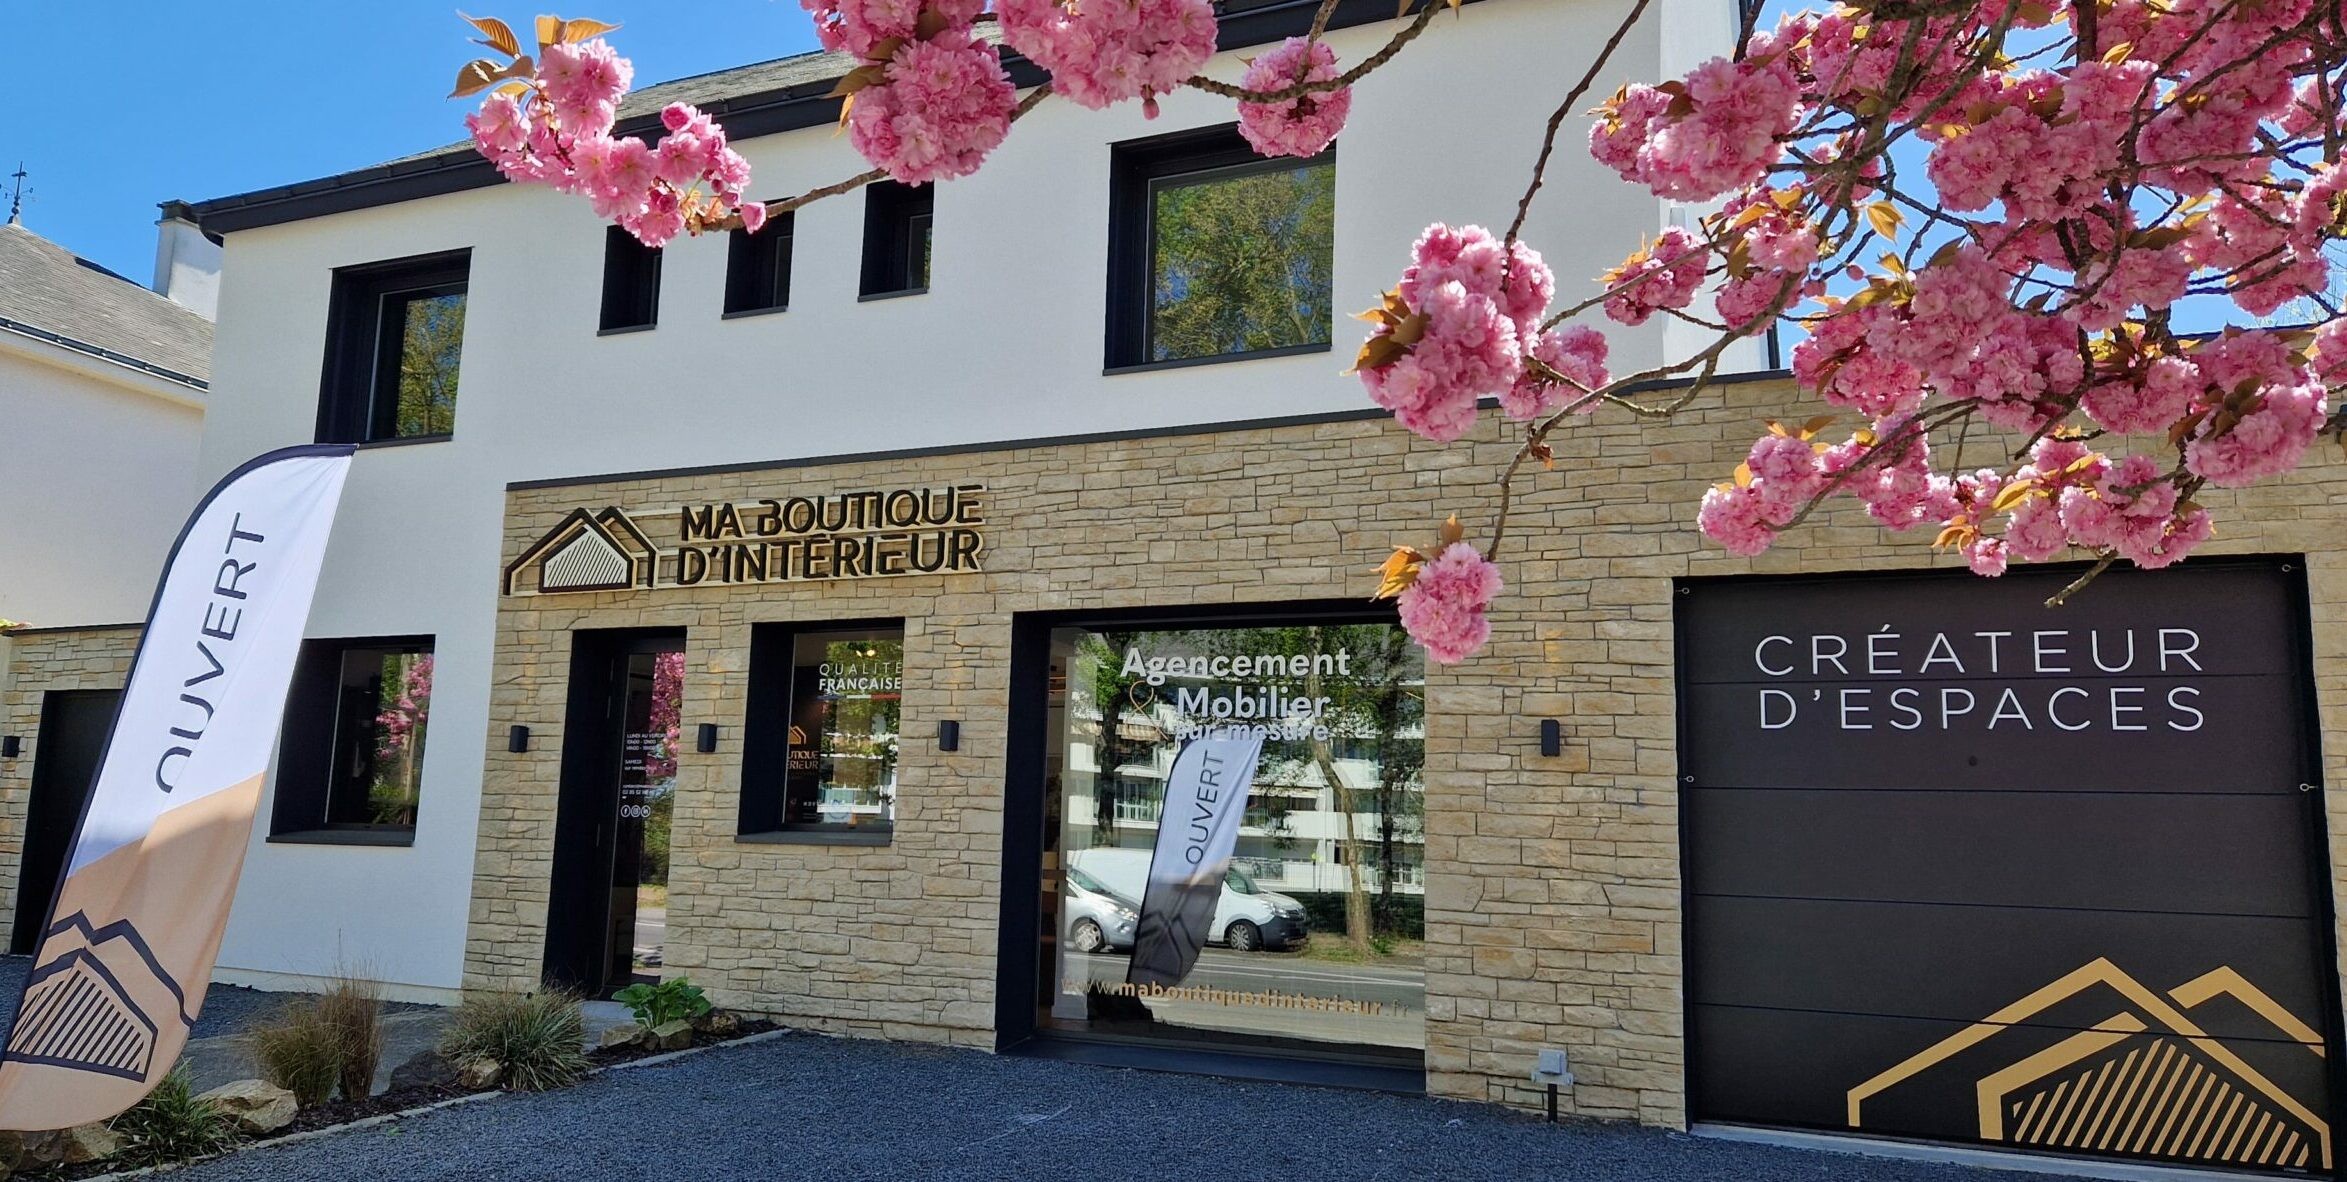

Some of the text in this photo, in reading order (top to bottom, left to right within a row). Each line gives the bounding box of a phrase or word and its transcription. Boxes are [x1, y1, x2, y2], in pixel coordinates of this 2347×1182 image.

[682, 484, 983, 541] MA BOUTIQUE
[676, 529, 981, 586] D'INTÉRIEUR
[155, 512, 264, 794] OUVERT
[1120, 647, 1351, 687] Agencement
[1755, 624, 2203, 676] CRÉATEUR
[818, 677, 902, 694] FRANÇAISE
[1177, 686, 1332, 719] Mobilier
[1759, 687, 2204, 731] D'ESPACES
[1175, 723, 1329, 742] sur mesure
[1185, 750, 1224, 865] OUVERT
